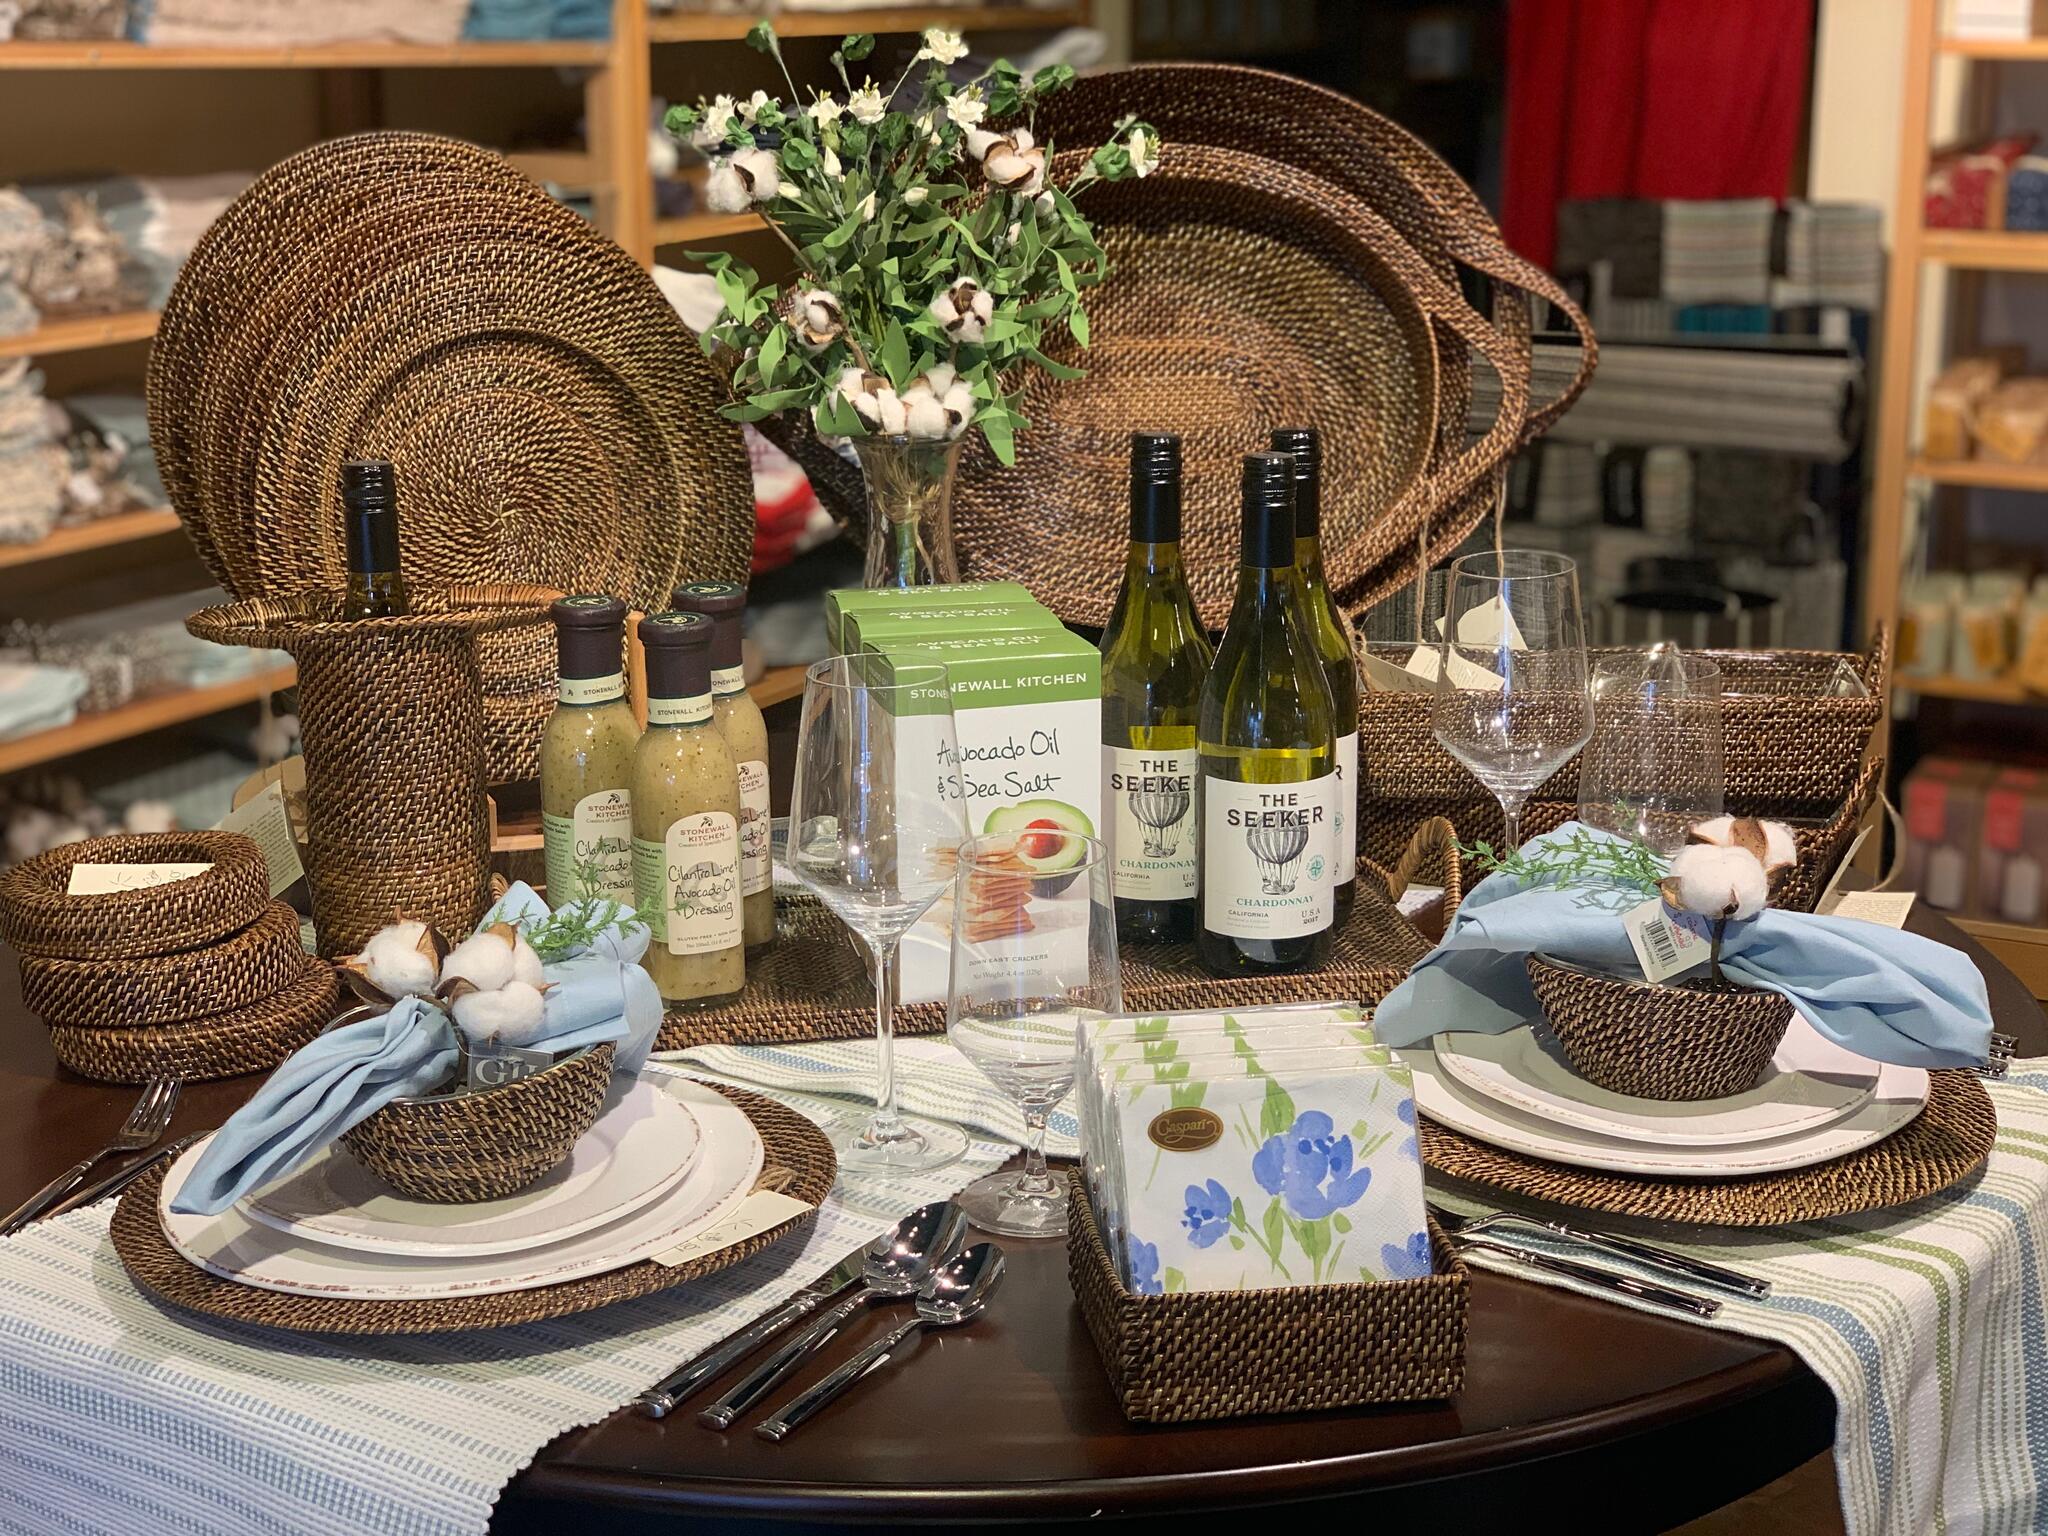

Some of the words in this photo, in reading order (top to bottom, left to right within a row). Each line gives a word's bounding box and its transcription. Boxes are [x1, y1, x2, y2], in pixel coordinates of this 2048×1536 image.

[1016, 672, 1087, 687] KITCHEN
[1030, 727, 1060, 756] Oil
[1140, 759, 1178, 773] THE
[1005, 771, 1061, 798] Salt
[1111, 773, 1192, 794] SEEKE
[588, 802, 630, 812] STONEWA
[1259, 793, 1299, 807] THE
[1227, 805, 1324, 829] SEEKER
[680, 824, 730, 836] STONEWALL
[688, 831, 725, 842] KITCHEN
[668, 864, 710, 883] Cilantro
[711, 861, 734, 877] Lime
[1112, 870, 1151, 880] CALIFORNIA
[674, 882, 722, 899] Avocado
[723, 877, 736, 891] Oil
[1236, 895, 1313, 908] CHARDONNAY
[683, 901, 734, 921] Dressing
[1228, 909, 1269, 918] CALIFORNIA
[1156, 1118, 1212, 1140] Caspari
